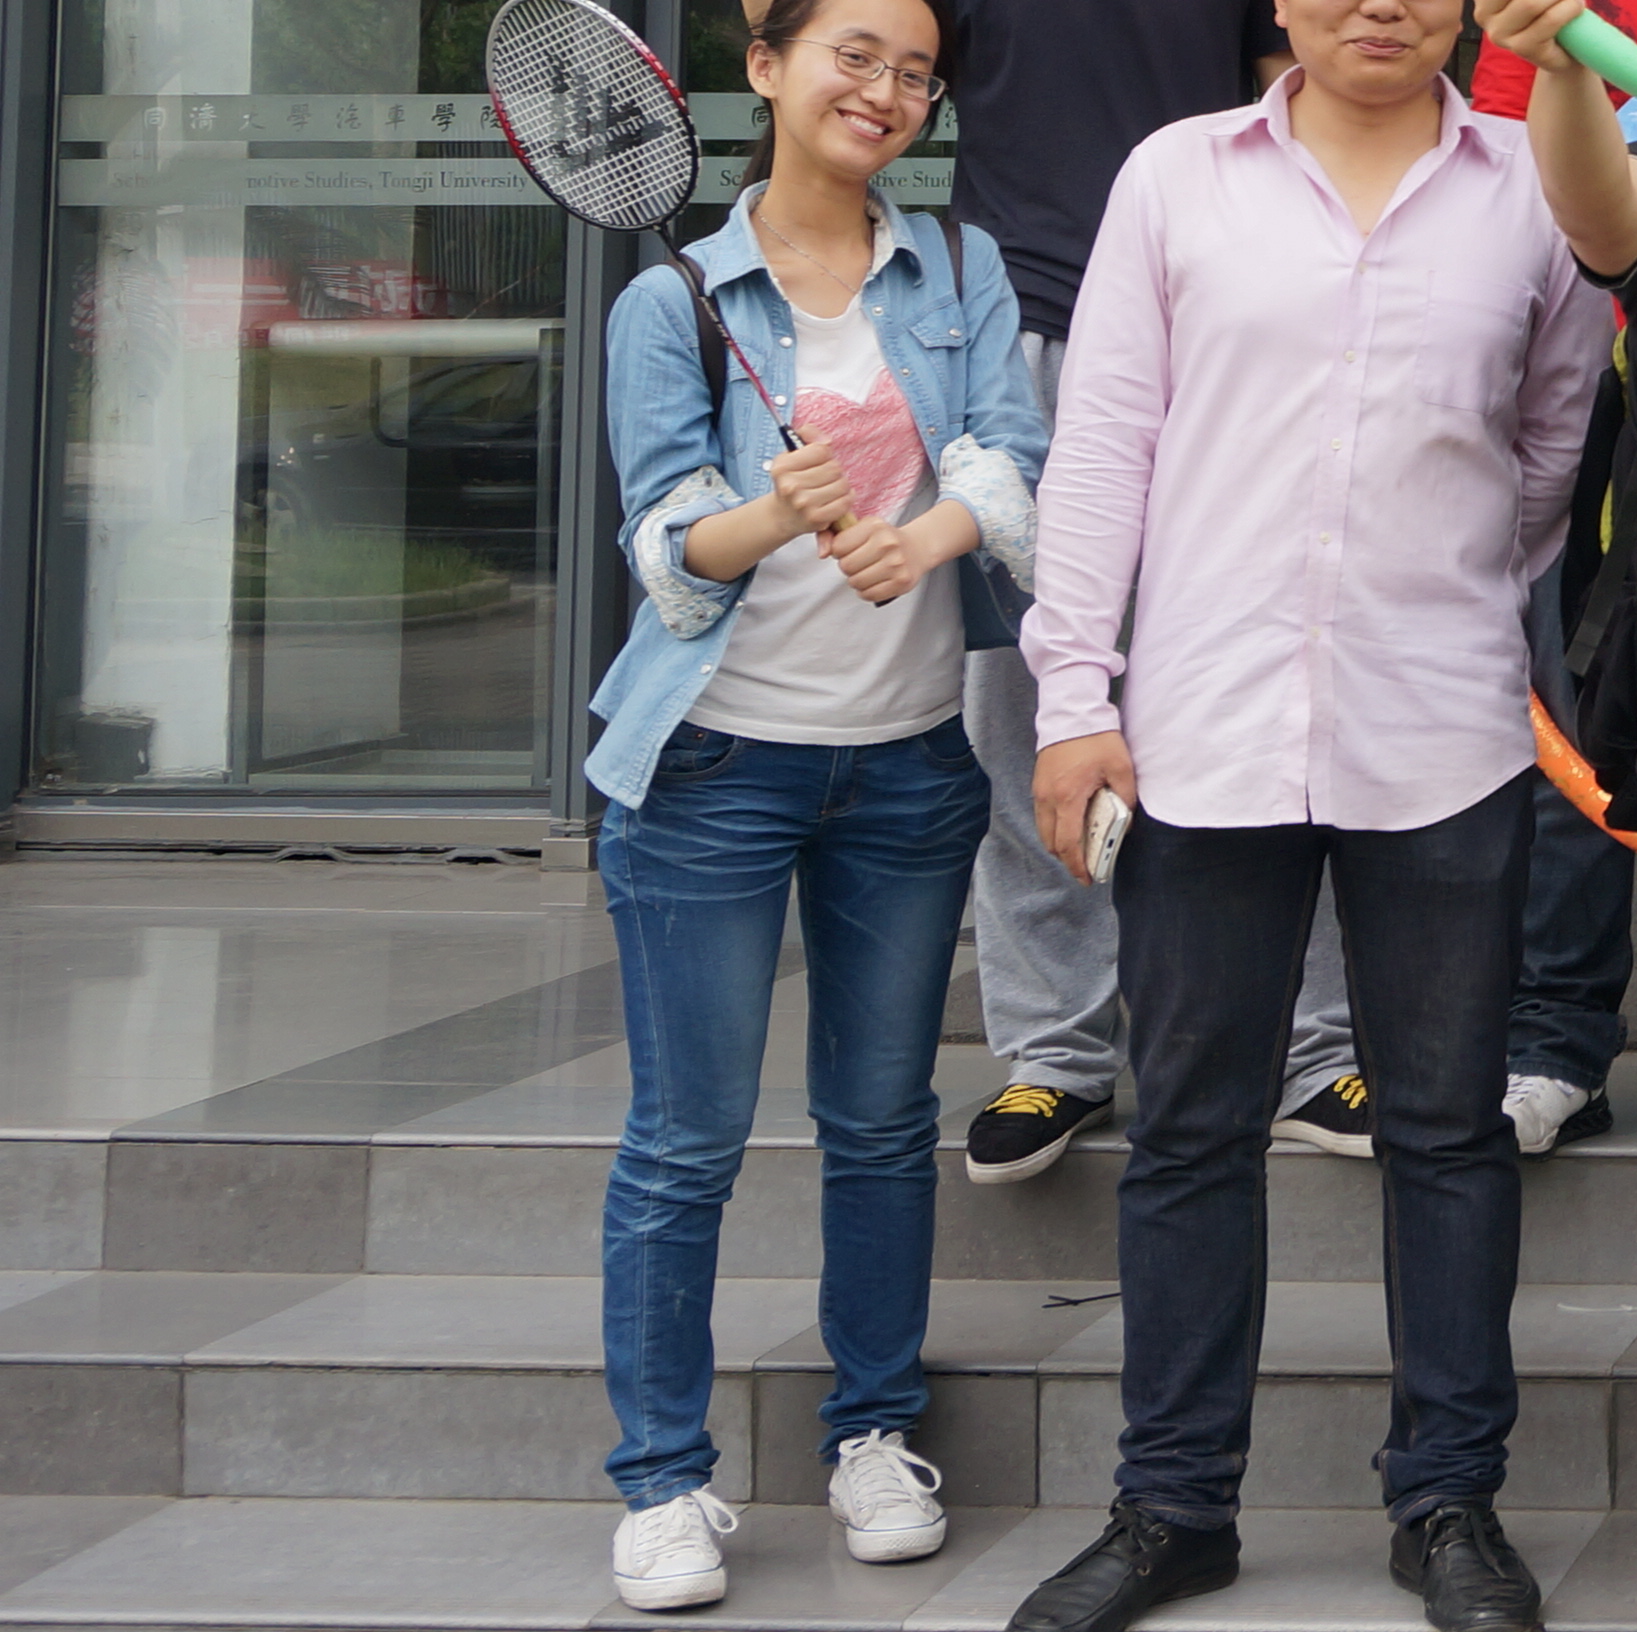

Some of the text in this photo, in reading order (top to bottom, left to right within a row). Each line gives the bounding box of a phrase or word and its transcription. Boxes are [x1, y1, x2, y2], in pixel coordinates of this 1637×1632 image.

[304, 171, 374, 189] Studies,
[379, 171, 433, 192] Tongji
[440, 171, 528, 191] University
